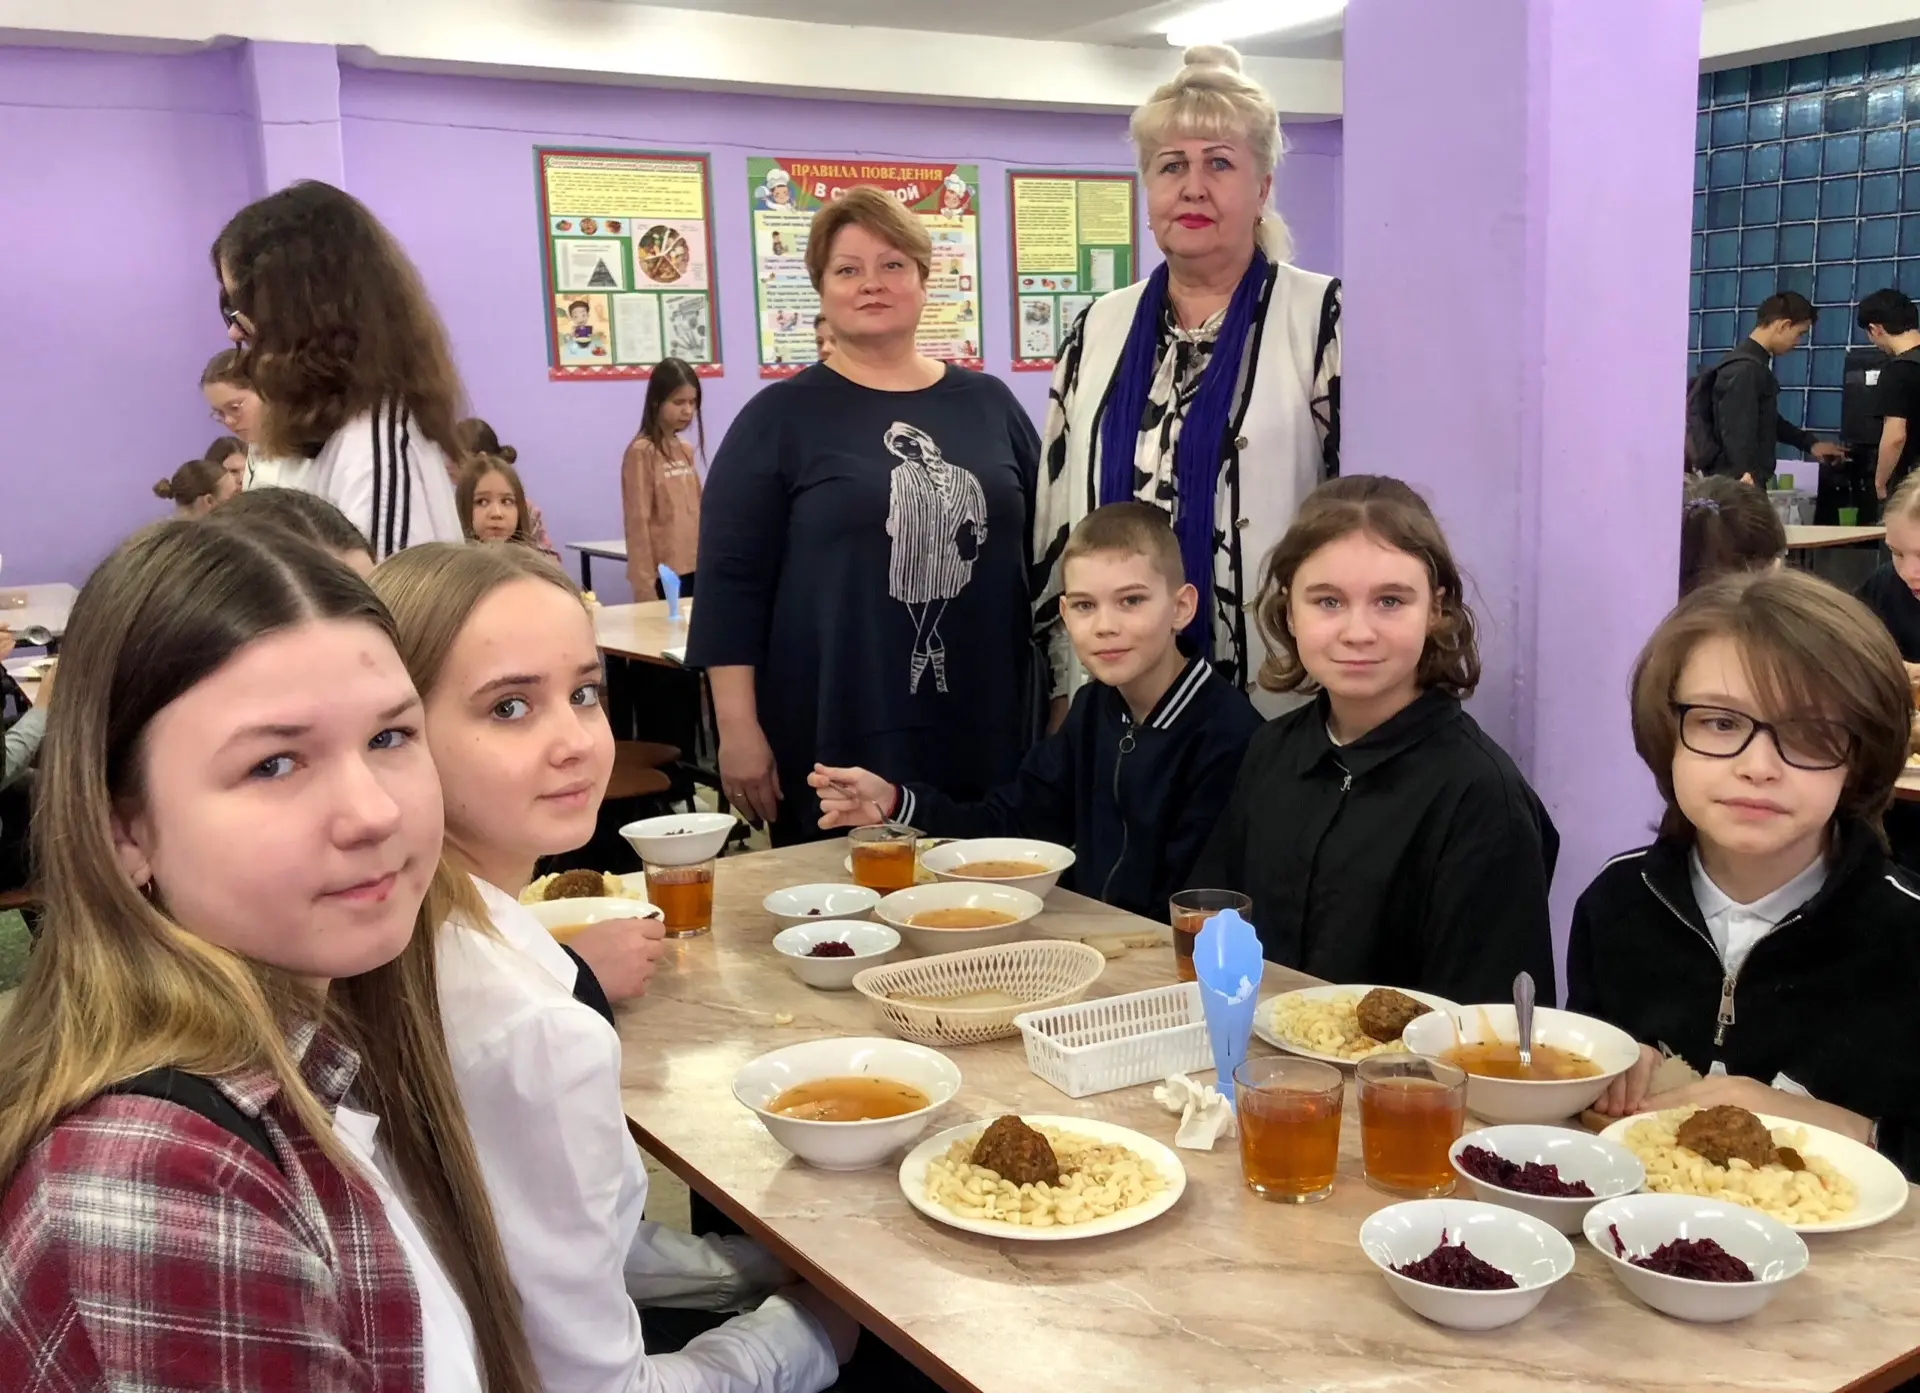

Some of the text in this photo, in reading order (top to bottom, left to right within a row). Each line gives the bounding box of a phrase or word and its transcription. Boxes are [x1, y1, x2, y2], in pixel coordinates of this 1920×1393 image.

[791, 164, 943, 181] ПРАВИЛА ПОВЕДЕНИЯ
[814, 182, 826, 198] В
